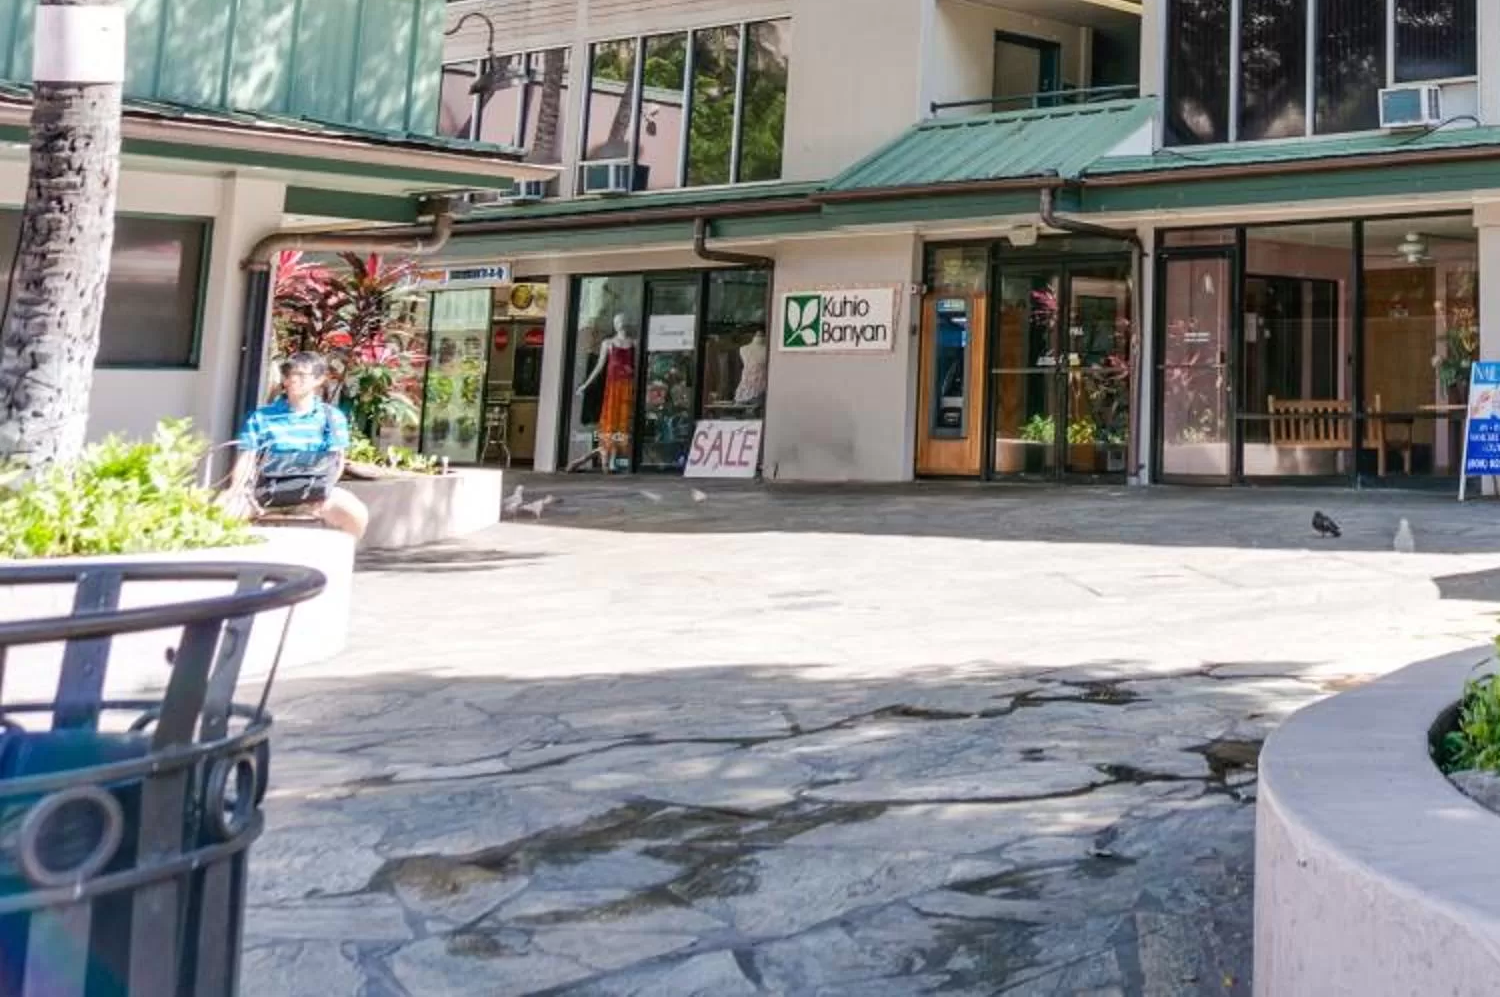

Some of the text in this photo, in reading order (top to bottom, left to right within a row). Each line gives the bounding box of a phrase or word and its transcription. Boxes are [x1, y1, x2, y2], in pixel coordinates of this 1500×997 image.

[823, 296, 869, 318] Kuhio
[821, 322, 887, 347] Banyan
[690, 429, 758, 467] SALE
